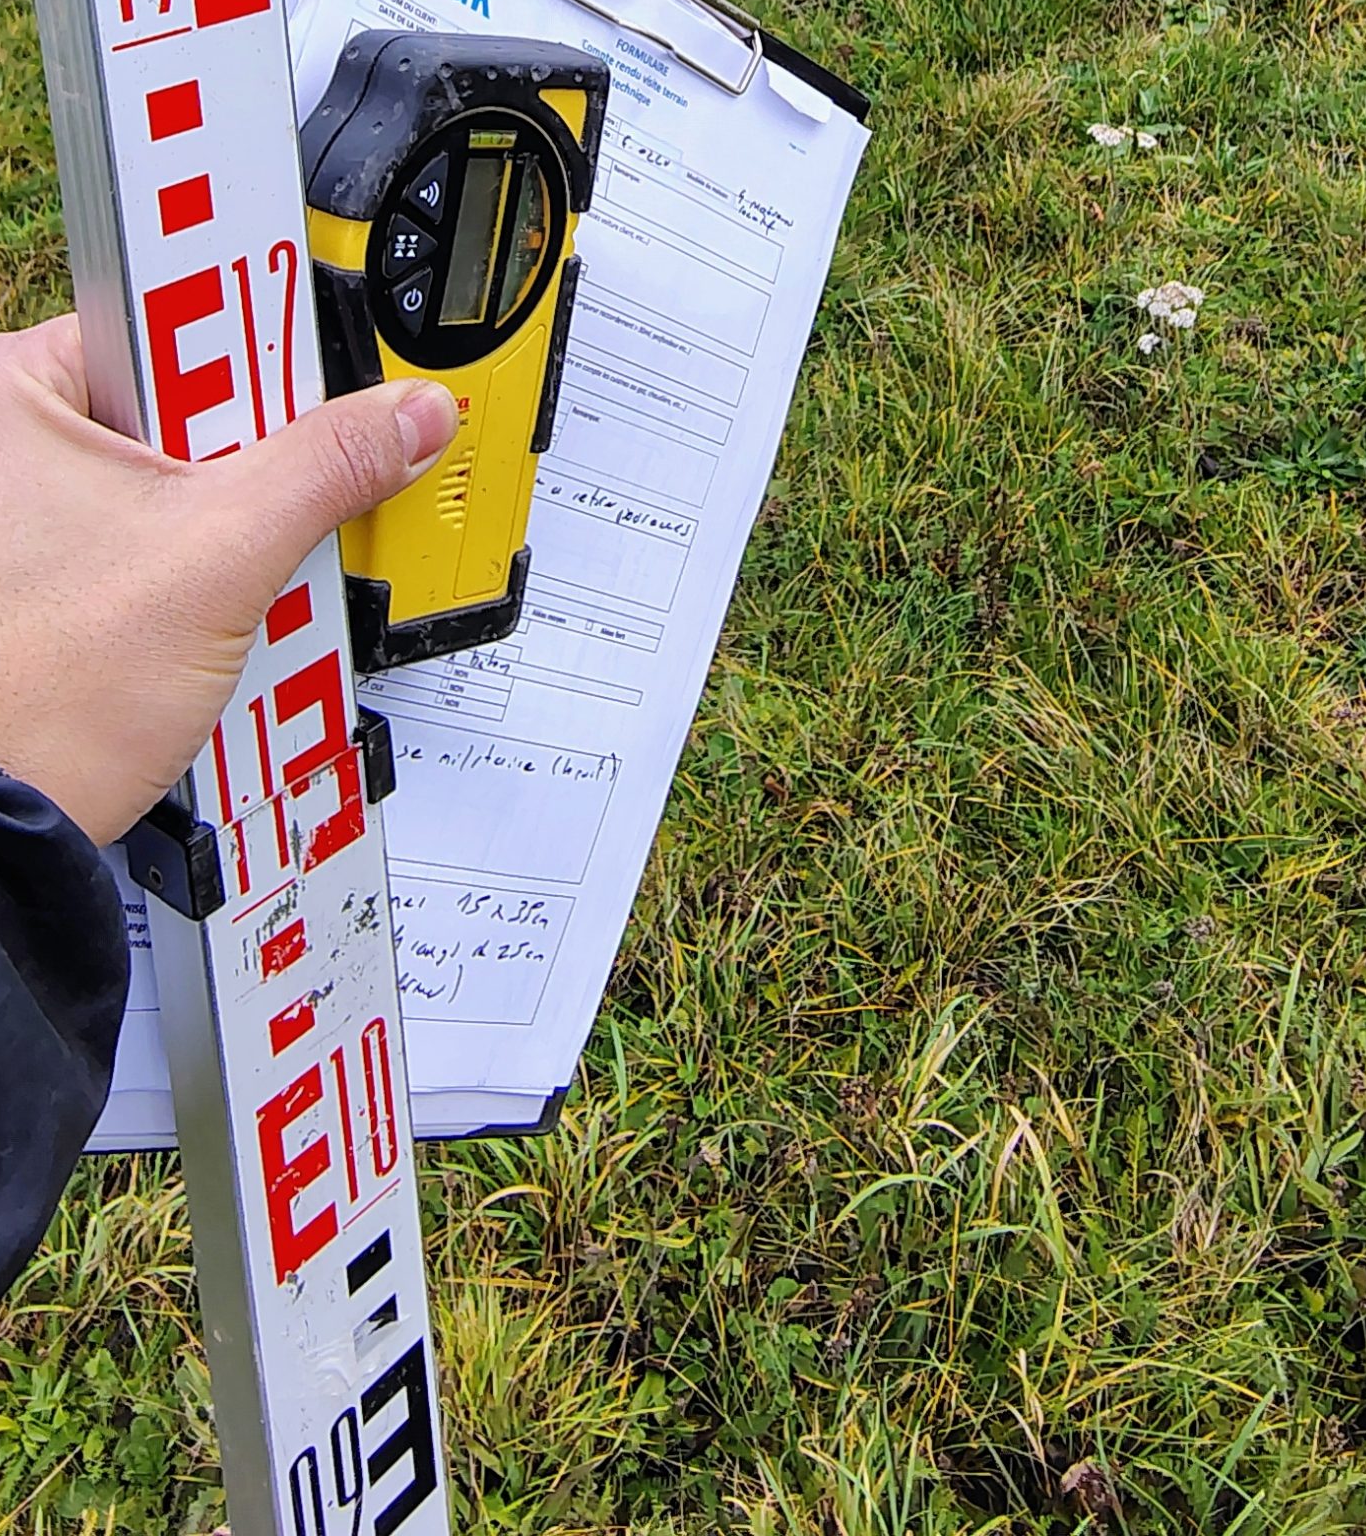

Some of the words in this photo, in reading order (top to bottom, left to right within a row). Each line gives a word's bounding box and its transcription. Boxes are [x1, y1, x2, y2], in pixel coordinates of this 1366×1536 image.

[379, 5, 396, 20] DATE
[397, 16, 406, 25] DE
[403, 1, 414, 13] DU
[616, 38, 670, 77] FORMULAIRE
[582, 39, 614, 65] Compte
[615, 60, 642, 80] rendu
[643, 75, 662, 93] visite
[663, 87, 689, 108] terrain
[612, 78, 651, 106] technique
